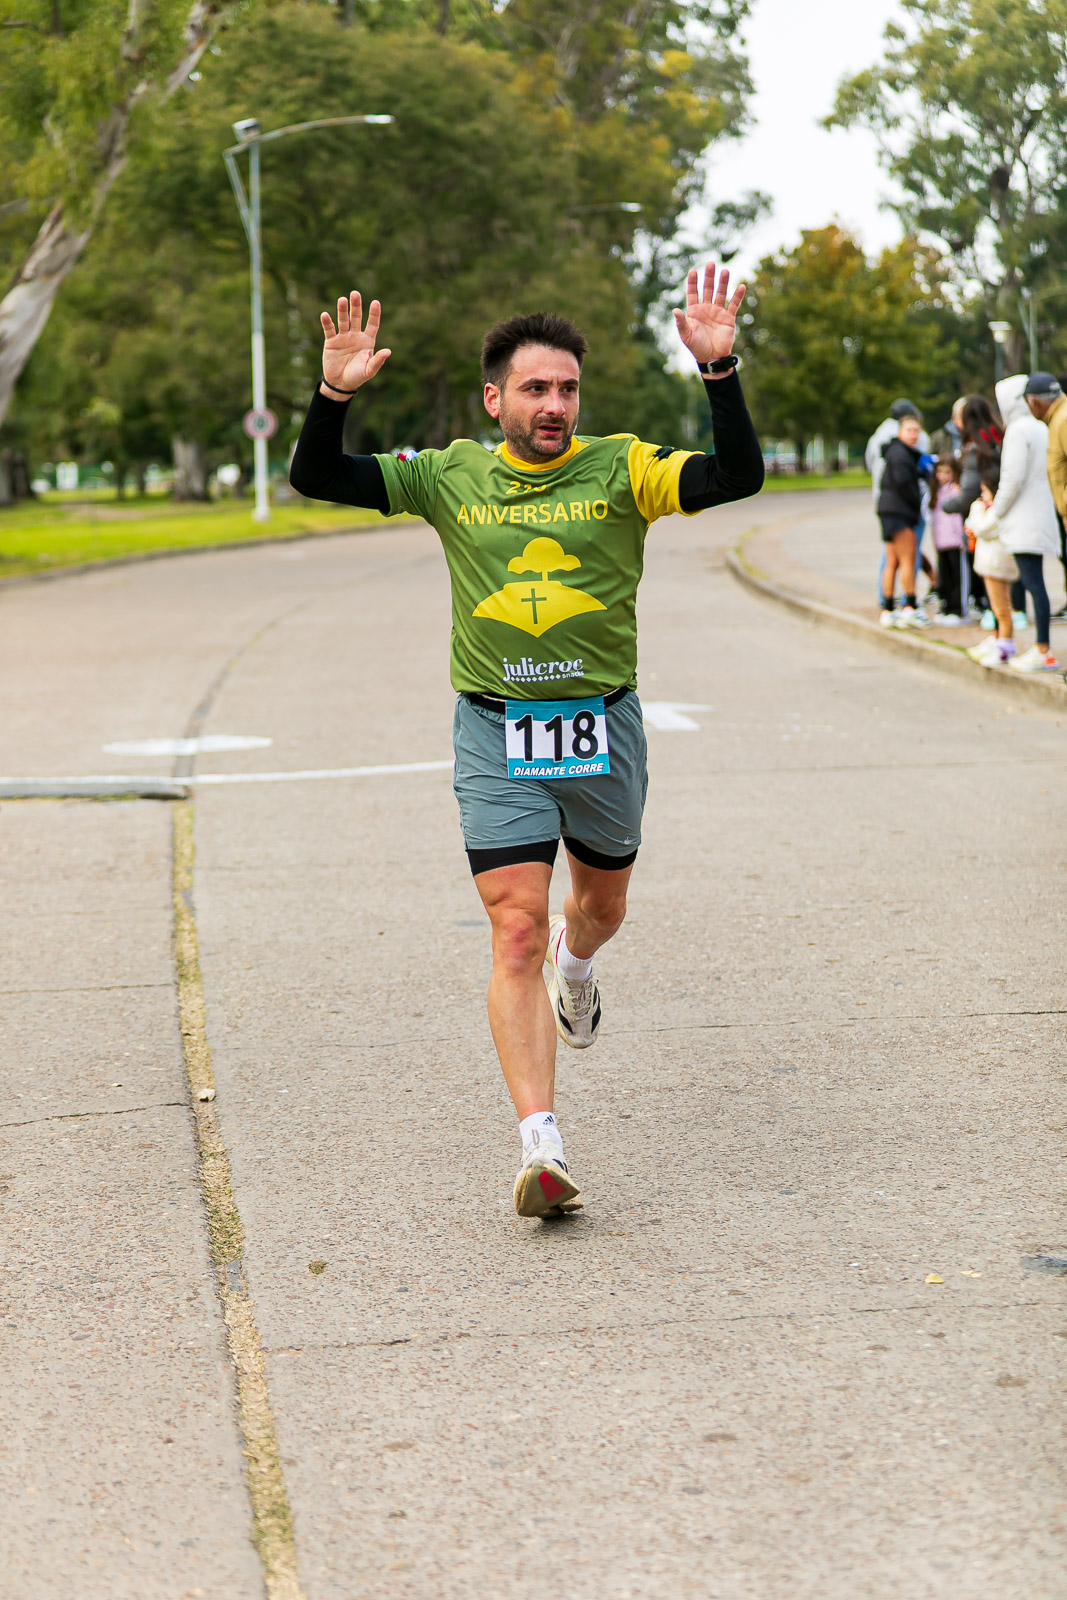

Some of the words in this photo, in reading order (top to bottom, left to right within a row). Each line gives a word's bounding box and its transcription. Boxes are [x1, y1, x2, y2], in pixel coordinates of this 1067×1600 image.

[457, 500, 608, 525] ANIVERSARIO
[502, 657, 583, 682] julicroc
[514, 709, 599, 763] 118
[513, 766, 567, 777] DIAMANTE
[568, 763, 604, 775] CORRE
